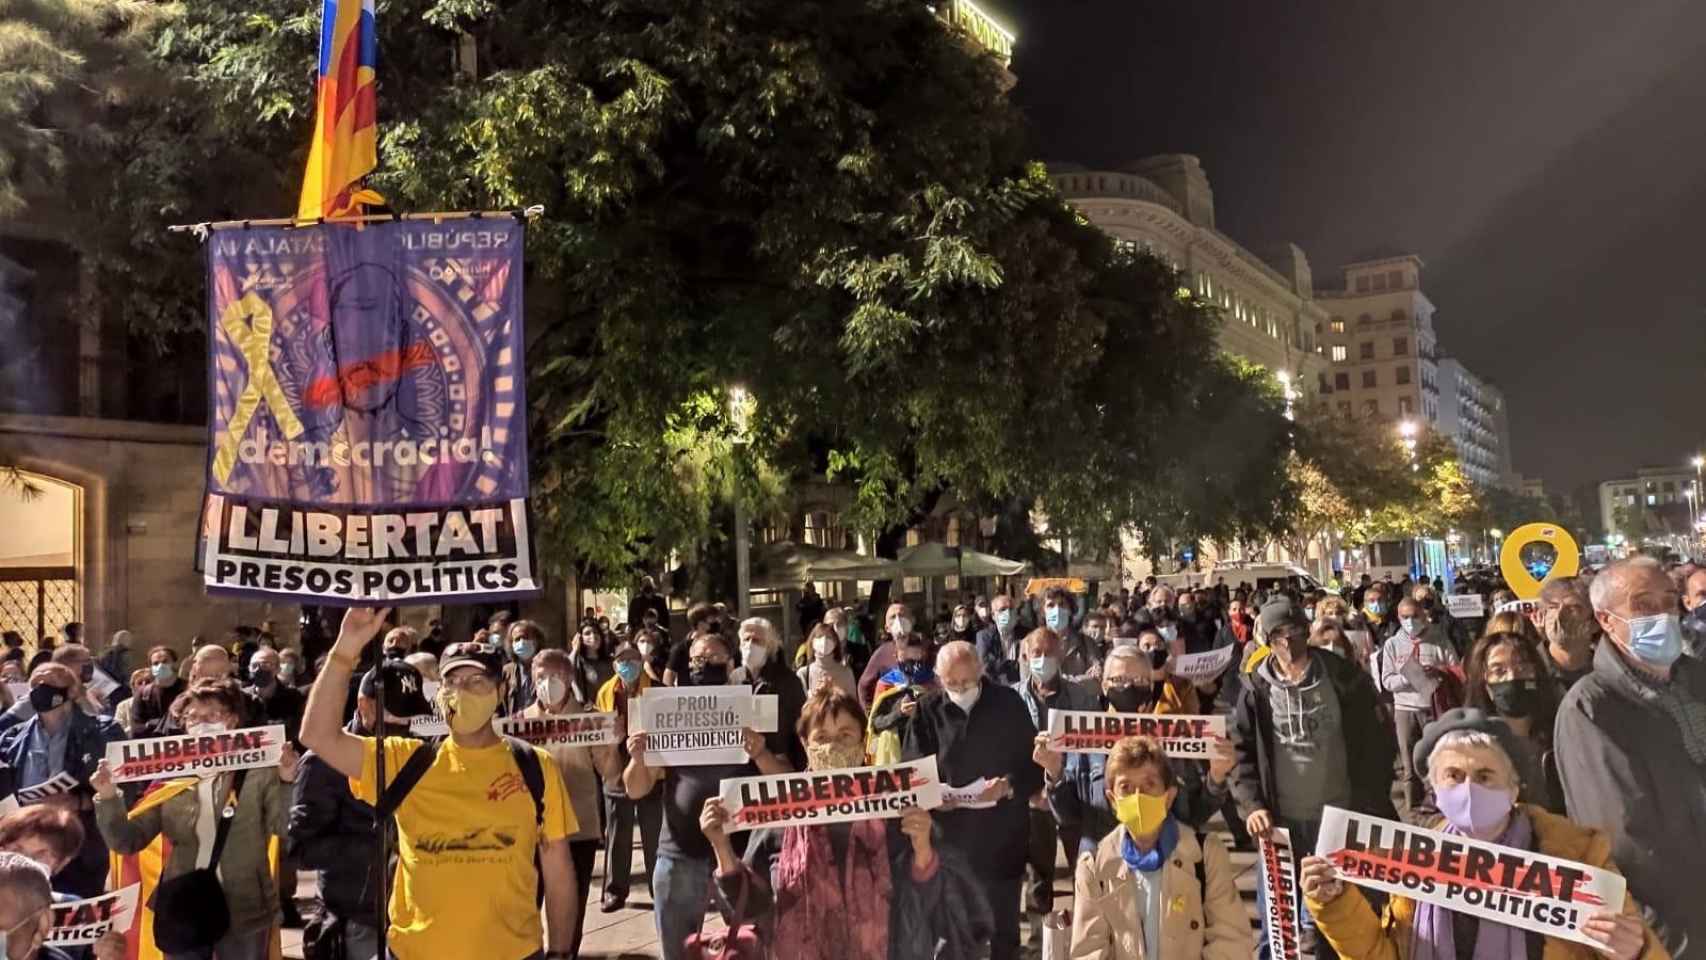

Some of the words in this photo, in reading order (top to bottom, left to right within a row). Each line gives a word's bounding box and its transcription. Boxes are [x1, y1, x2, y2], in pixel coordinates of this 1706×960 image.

[228, 505, 504, 560] LLIBERTAT
[216, 559, 353, 594] PRESOS
[362, 557, 519, 596] POLÍTICS
[655, 706, 740, 729] REPRESSIÓ:
[677, 696, 717, 711] PROU
[1064, 715, 1207, 738] LLIBERTAT
[122, 730, 265, 764] LLIBERTAT
[1064, 738, 1116, 752] PRESO
[125, 762, 185, 777] PRESOS
[741, 766, 915, 807] LLIBERTAT
[744, 807, 819, 824] PRESOS
[827, 793, 918, 817] POLÍTICS!
[1344, 818, 1584, 904] LLIBERTAT
[1273, 842, 1298, 960] LLIBERTA
[1342, 854, 1436, 895] PRESOS
[1446, 888, 1578, 930] POLÍTICS!
